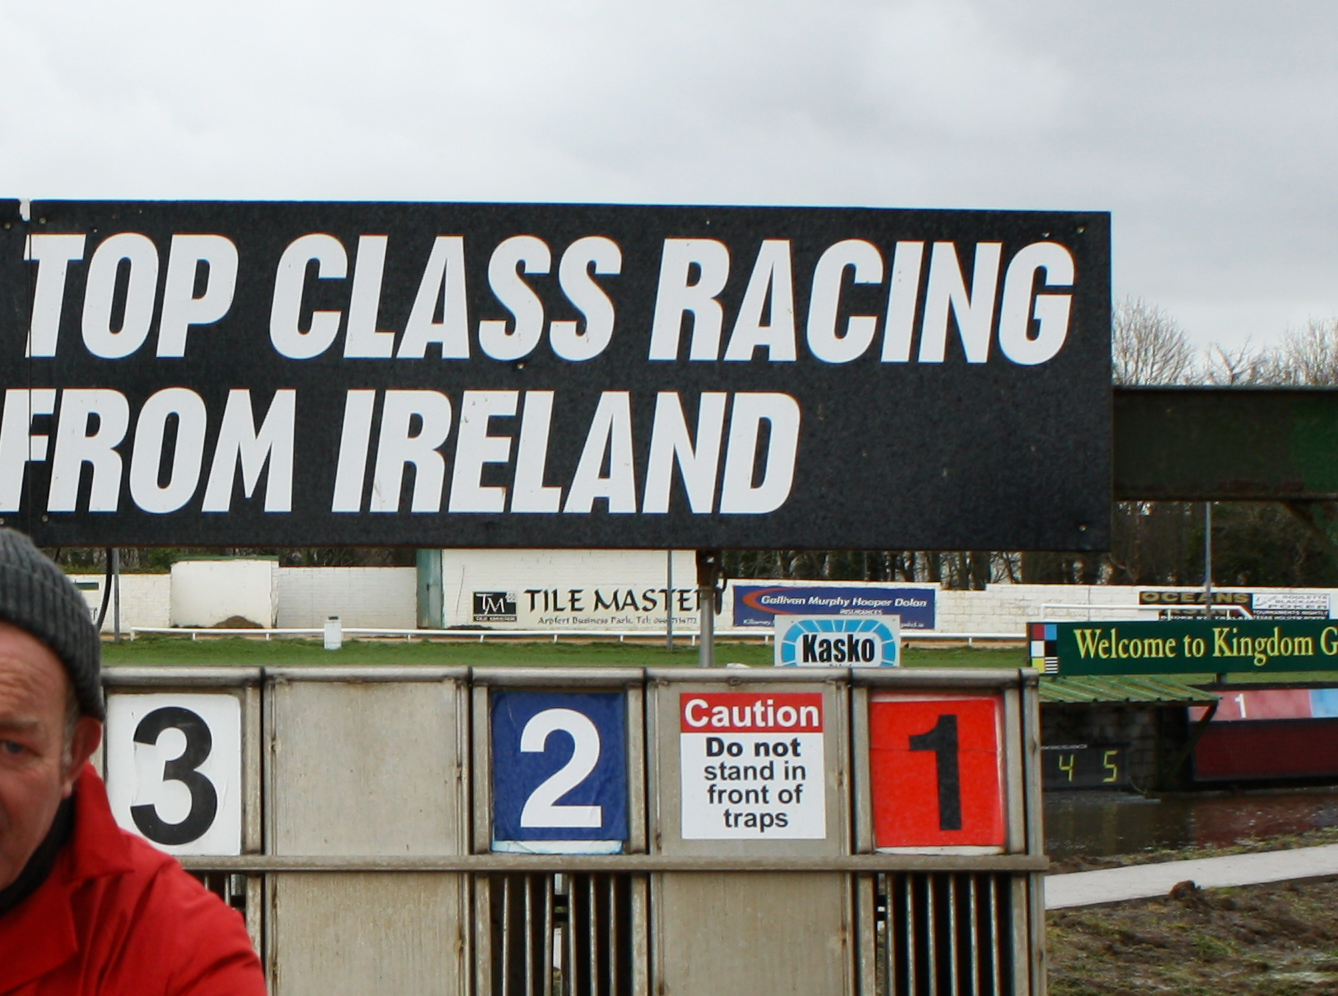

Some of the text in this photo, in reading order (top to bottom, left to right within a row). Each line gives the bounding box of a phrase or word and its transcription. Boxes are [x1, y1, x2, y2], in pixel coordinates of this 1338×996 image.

[24, 232, 1075, 366] TOP CLASS RACING
[331, 389, 801, 514] IRELAND
[524, 588, 585, 612] TILE
[807, 596, 851, 608] Murphy
[852, 597, 893, 608] Hooper
[894, 598, 928, 607] Dolan
[1141, 592, 1250, 604] OCEANS
[802, 633, 876, 664] Kasko
[1073, 627, 1178, 660] Welcome
[1183, 634, 1206, 658] to
[1212, 626, 1315, 667] Kingdom
[684, 698, 820, 728] Caution
[1234, 693, 1247, 719] 1
[705, 737, 801, 758] Do not
[130, 706, 218, 846] 3
[520, 708, 602, 828] 2
[703, 761, 807, 782] stand in
[908, 714, 962, 831] 1
[1058, 750, 1119, 782] 4 5
[706, 784, 803, 805] front of
[723, 808, 789, 831] traps
